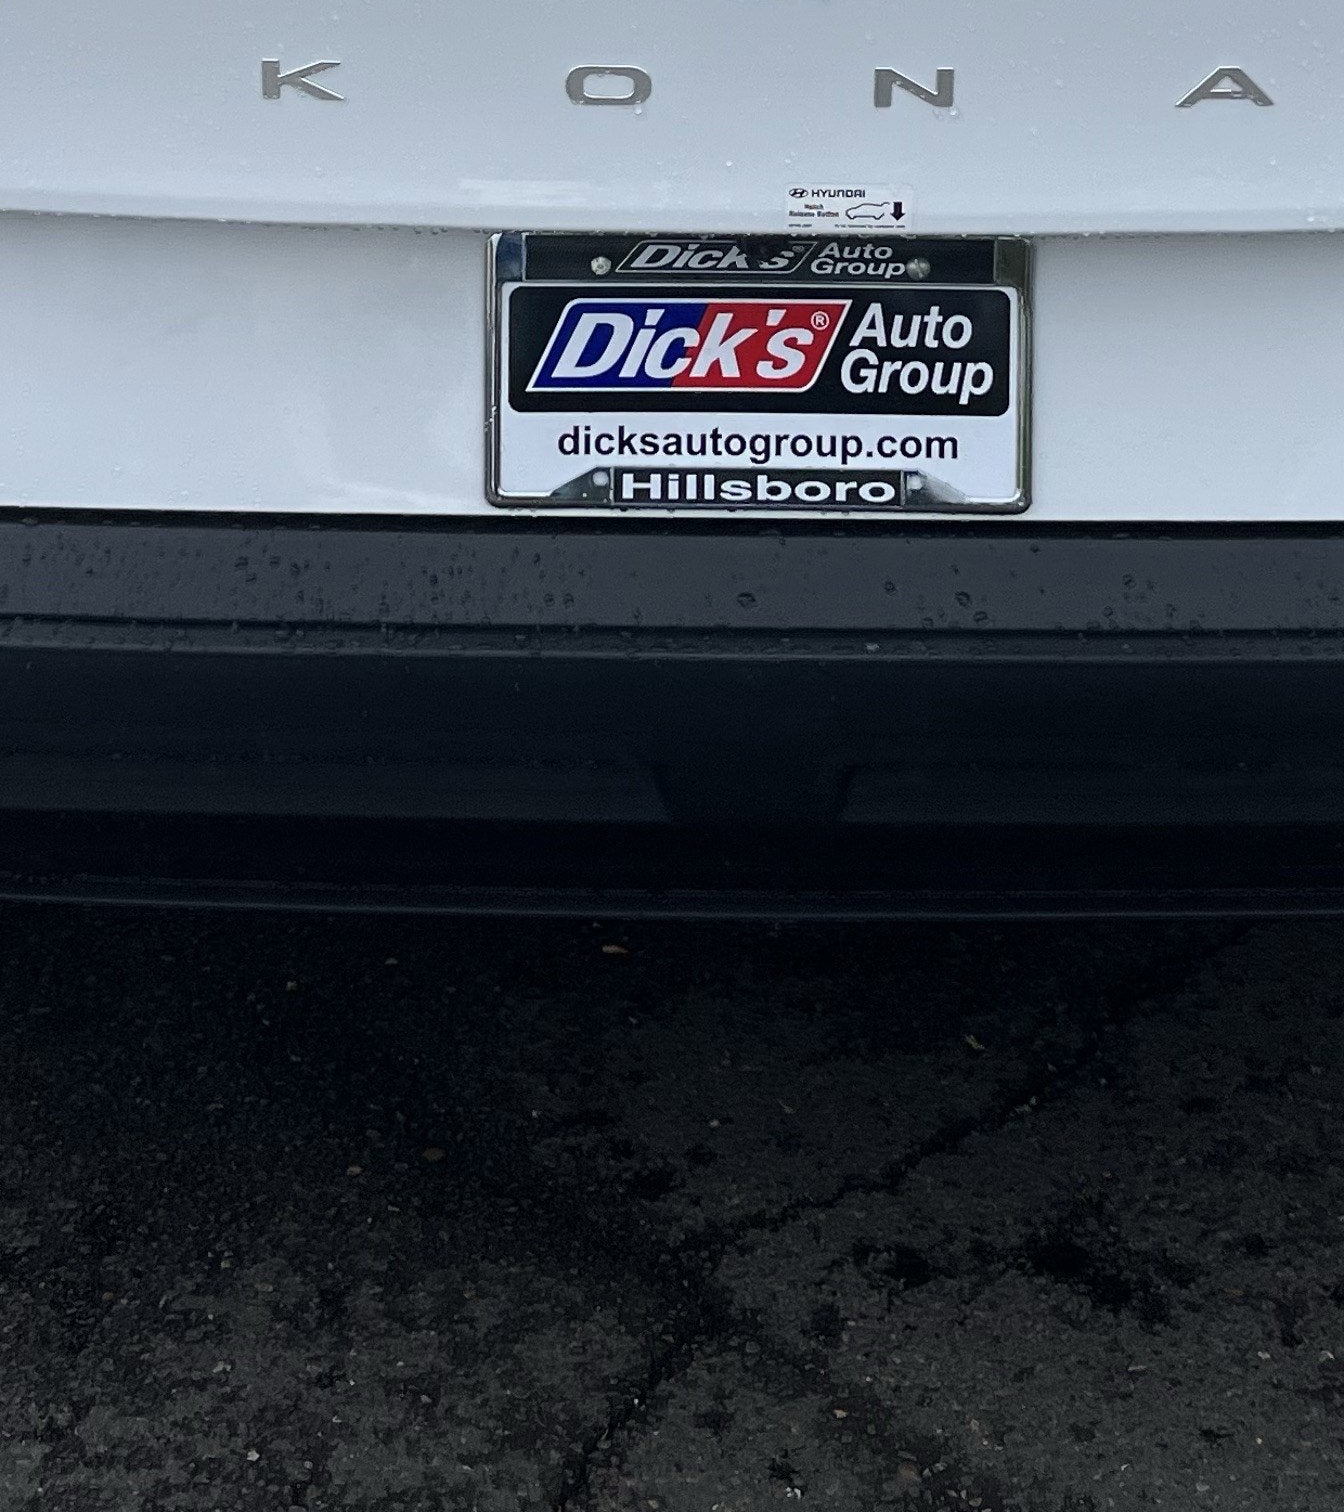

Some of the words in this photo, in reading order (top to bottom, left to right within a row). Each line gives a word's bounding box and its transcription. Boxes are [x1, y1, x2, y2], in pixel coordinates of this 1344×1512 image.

[261, 58, 1274, 108] KONA
[811, 189, 866, 198] HYUNDAI
[810, 257, 906, 279] Group
[818, 242, 893, 260] Auto
[849, 303, 974, 350] Auto
[839, 347, 995, 405] Group
[557, 425, 959, 464] dicksautogroup.com
[621, 473, 896, 504] Hillsboro
